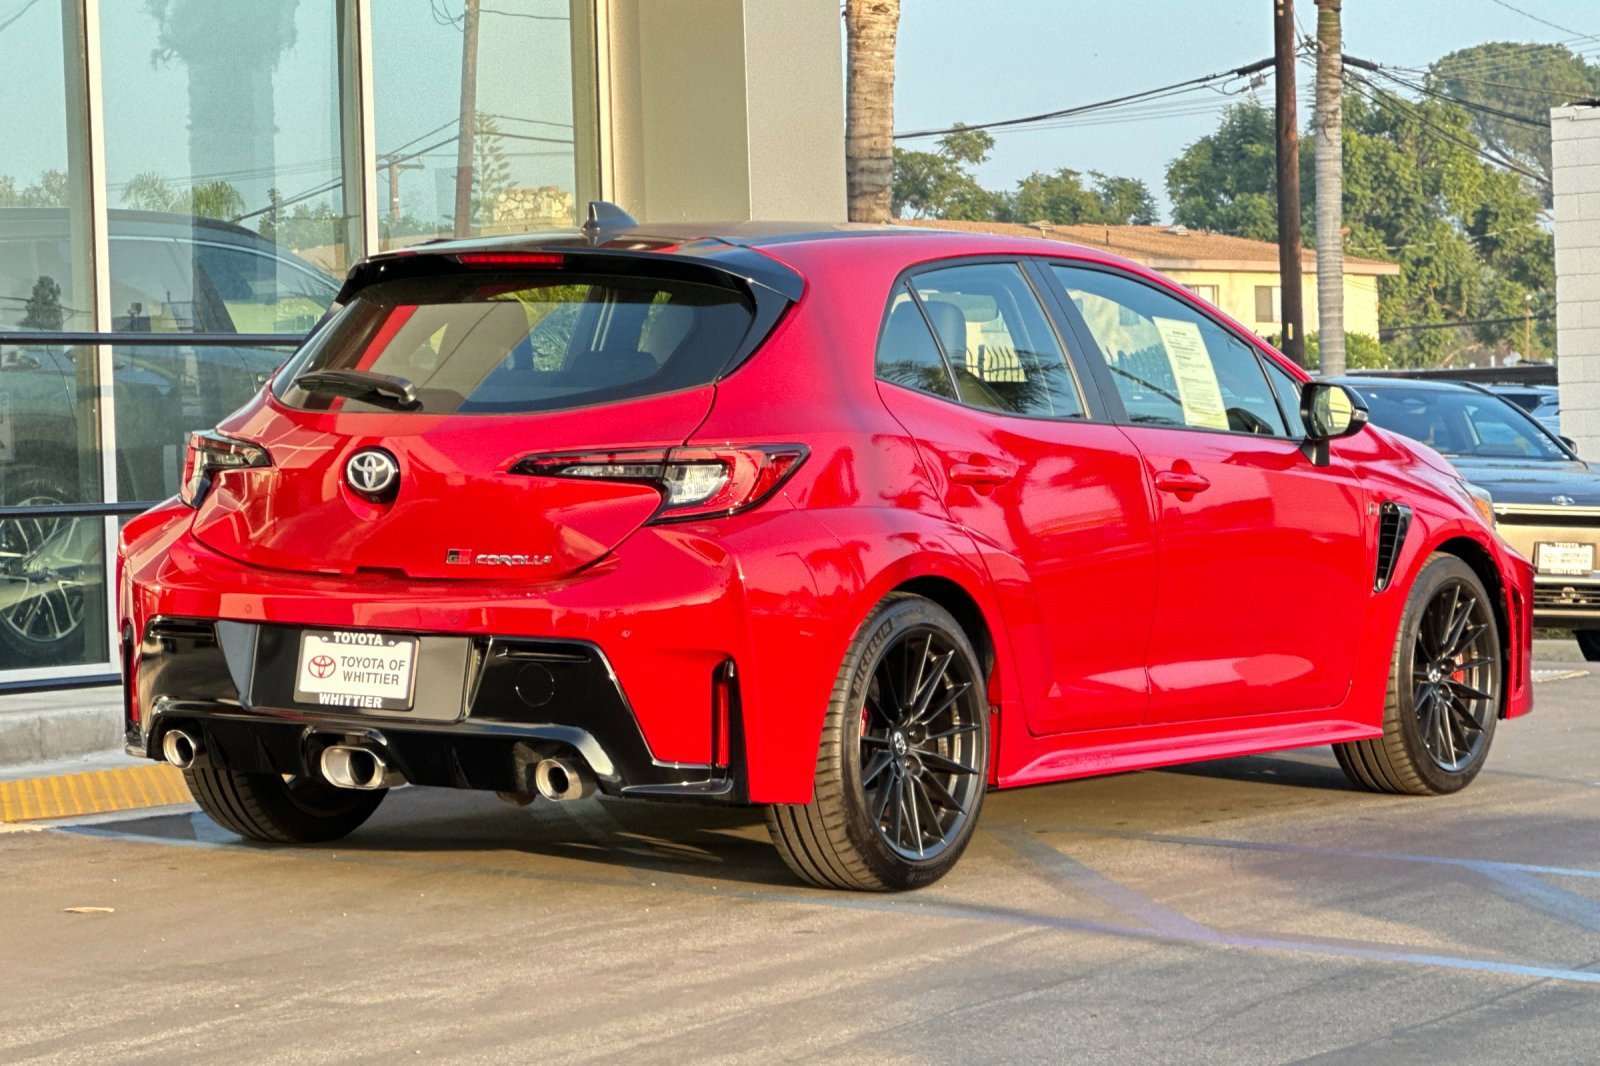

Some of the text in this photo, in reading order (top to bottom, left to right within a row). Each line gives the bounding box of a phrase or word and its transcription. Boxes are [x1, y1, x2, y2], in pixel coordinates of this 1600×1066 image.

[475, 554, 552, 567] COROLLA
[334, 631, 383, 646] TOYOTA
[341, 656, 406, 671] TOYOTA OF
[343, 670, 399, 685] WHITTIER
[319, 692, 382, 708] WHITTIER
